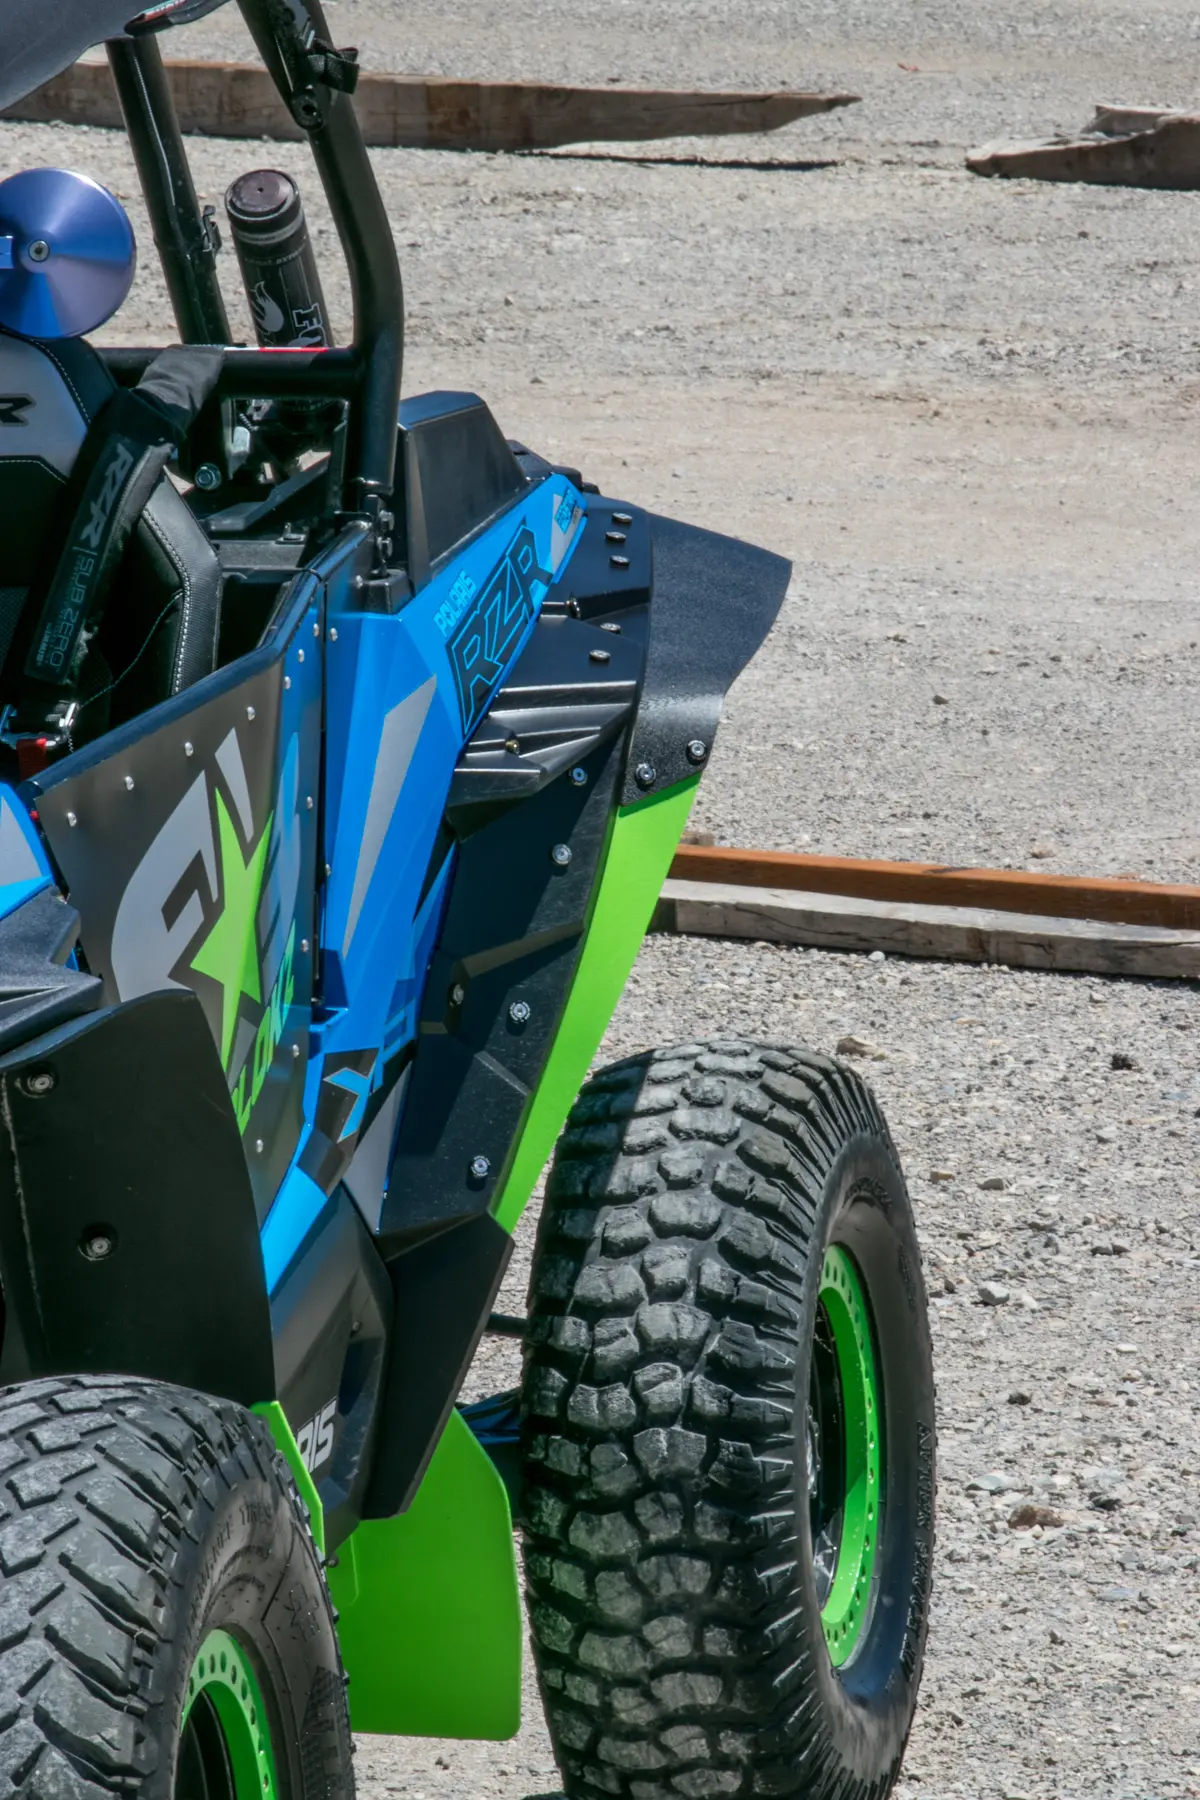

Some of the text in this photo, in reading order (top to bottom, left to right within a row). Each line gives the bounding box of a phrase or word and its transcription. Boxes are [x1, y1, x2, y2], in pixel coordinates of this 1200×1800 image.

[81, 442, 134, 549] RZR
[71, 558, 95, 603] SUB
[433, 570, 478, 637] POLARIS
[50, 607, 80, 667] ZERO
[450, 523, 554, 736] RZR
